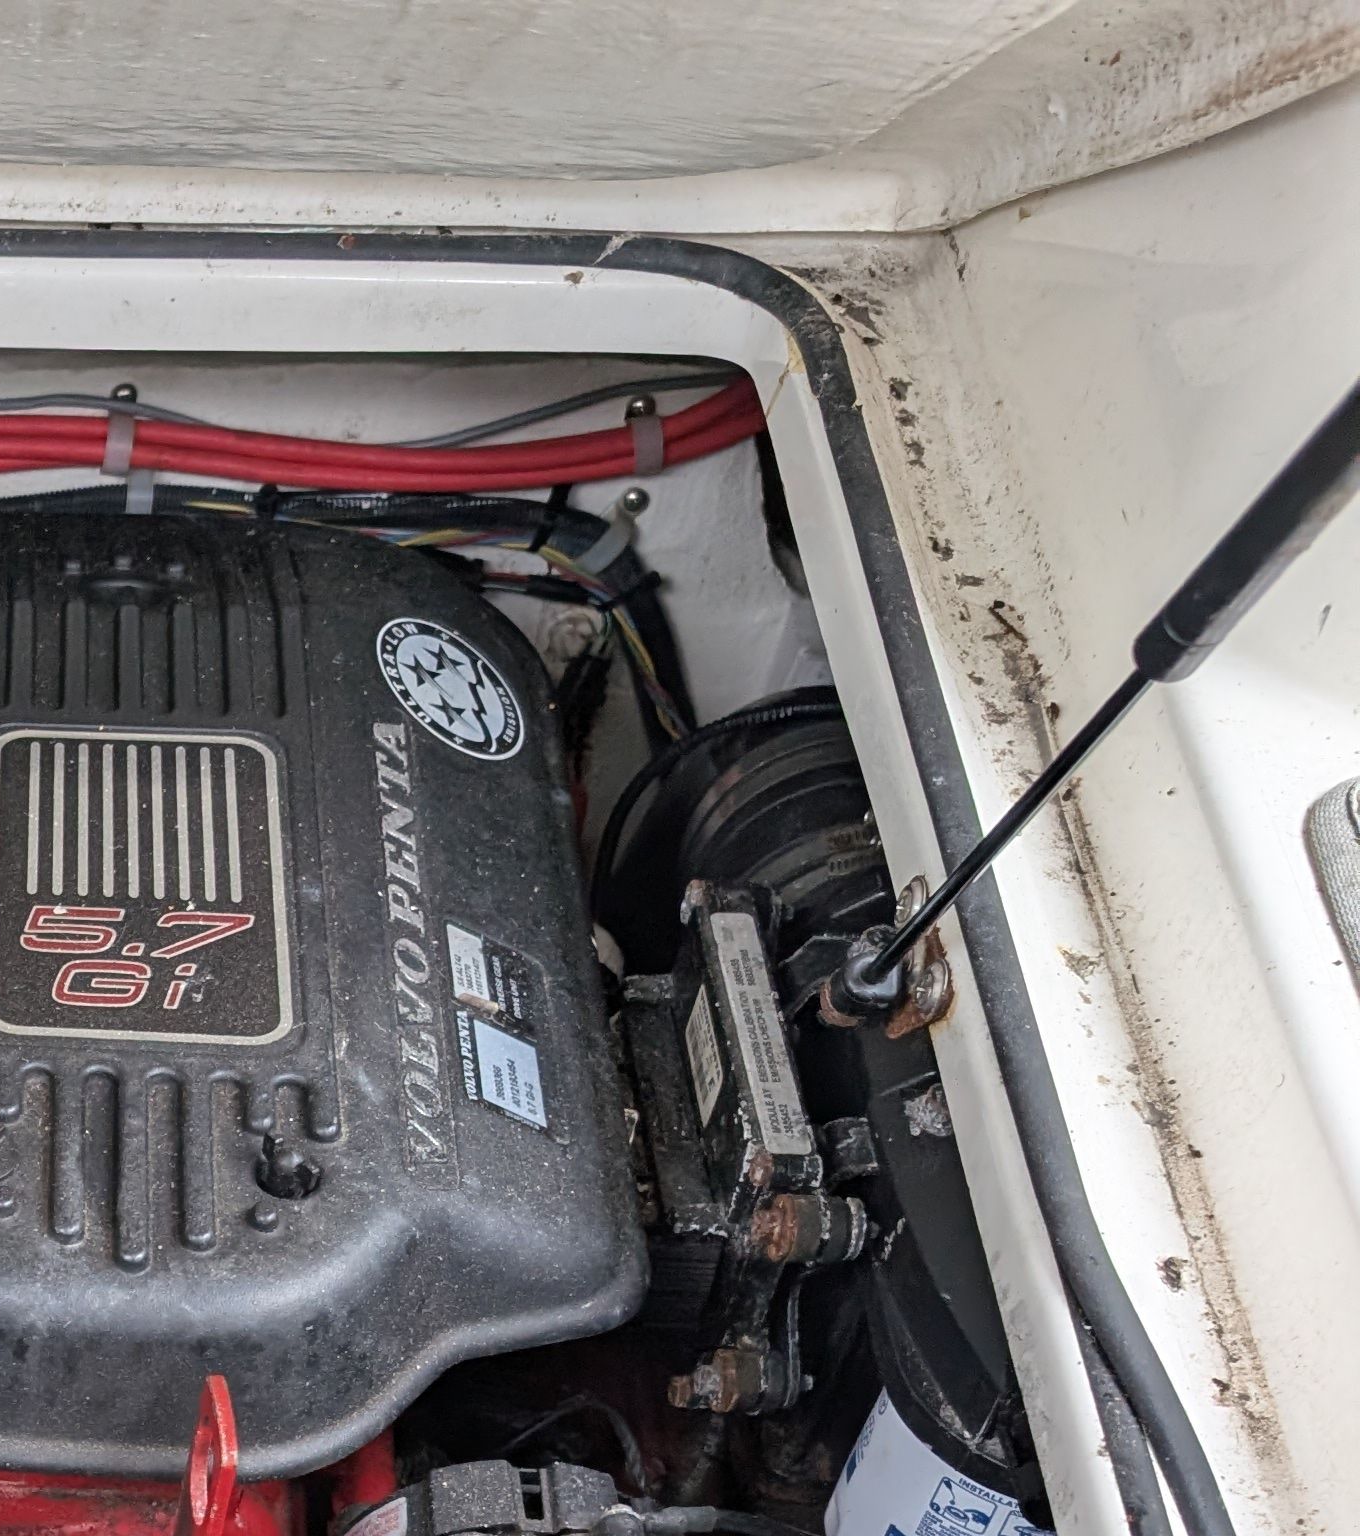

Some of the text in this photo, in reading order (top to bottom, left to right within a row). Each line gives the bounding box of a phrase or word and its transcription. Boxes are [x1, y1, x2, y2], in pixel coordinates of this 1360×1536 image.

[384, 623, 419, 645] LOW
[18, 904, 255, 959] 5.7
[374, 718, 450, 1165] VOLVO PENTA
[52, 960, 200, 1009] Gi
[456, 1010, 478, 1101] VOLVO PENTA
